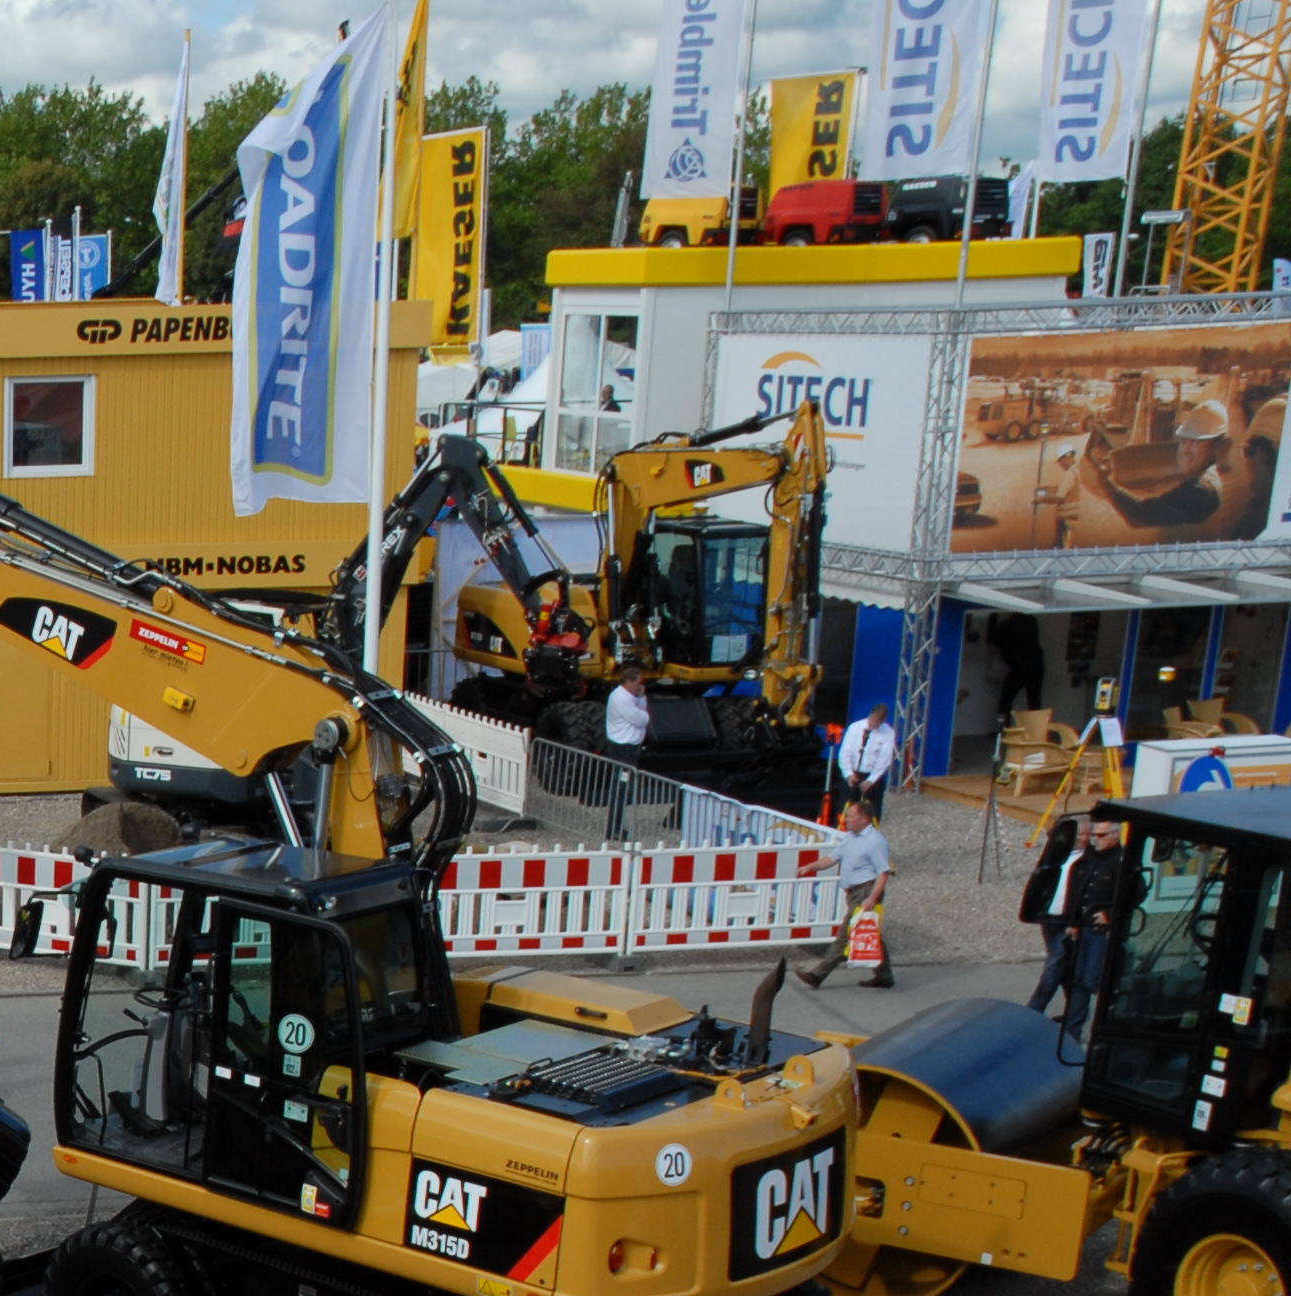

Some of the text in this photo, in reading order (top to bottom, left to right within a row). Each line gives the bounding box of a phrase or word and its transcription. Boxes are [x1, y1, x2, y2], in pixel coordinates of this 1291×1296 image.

[265, 125, 316, 447] OADRITE
[756, 373, 871, 428] SITECH
[32, 604, 86, 663] CAT
[137, 626, 180, 650] ZEPPELIN
[285, 1021, 307, 1047] 20
[505, 1158, 559, 1182] ZEPPELIN
[663, 1151, 686, 1178] 20
[414, 1170, 488, 1233] CAT
[754, 1147, 834, 1261] CAT
[411, 1224, 470, 1261] M315D
